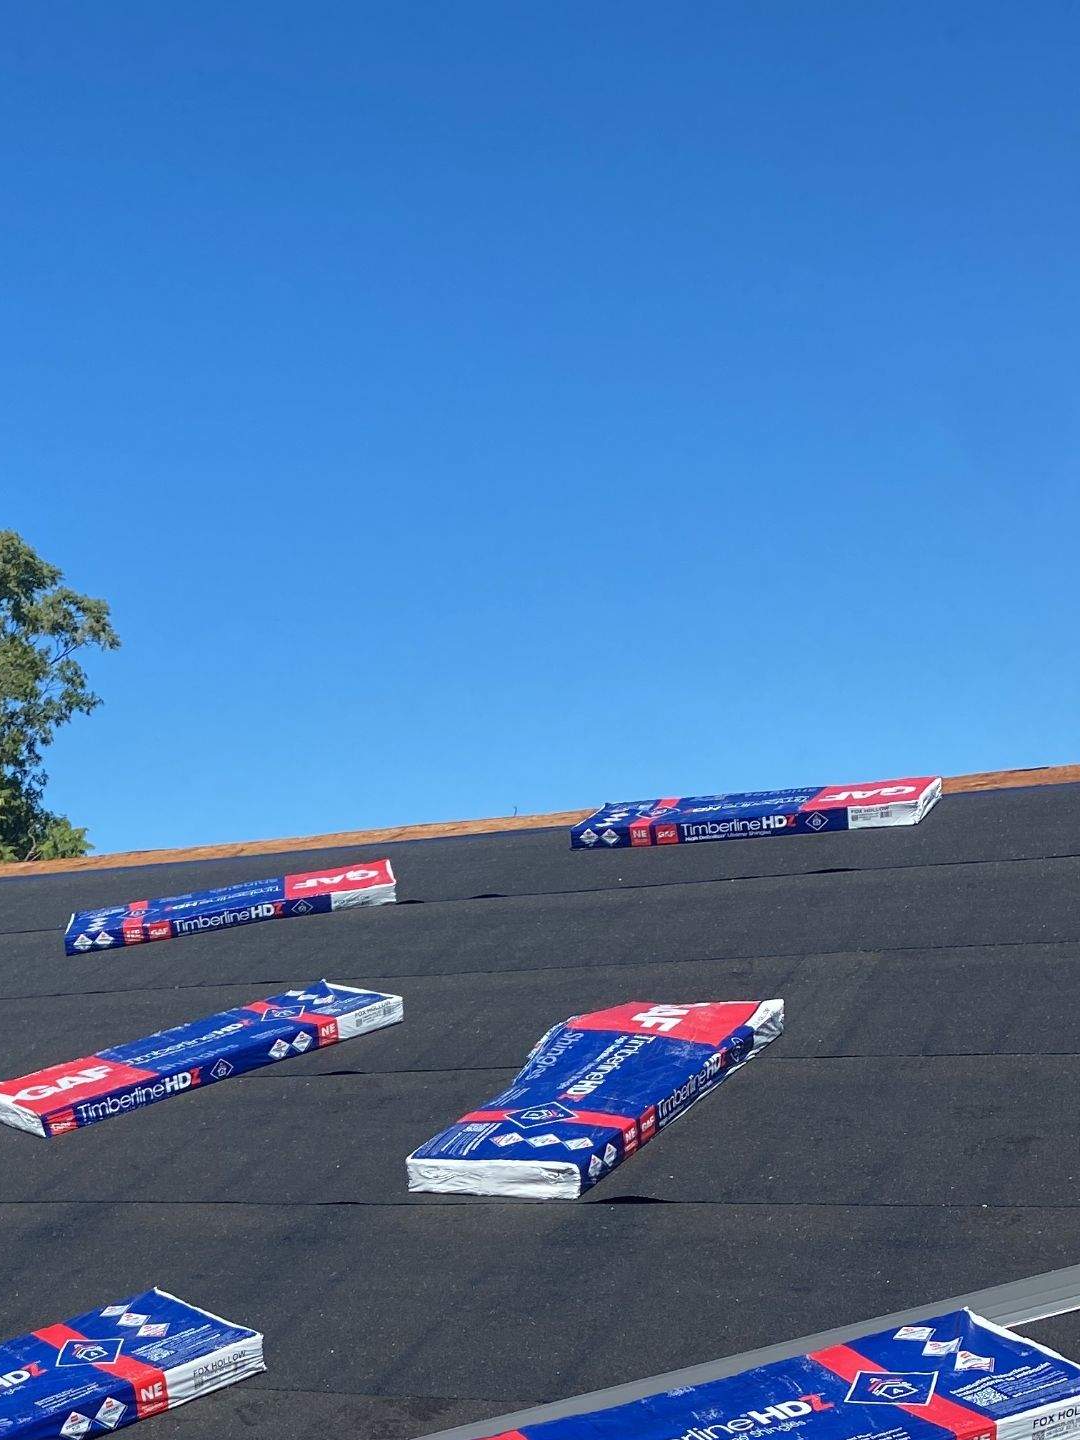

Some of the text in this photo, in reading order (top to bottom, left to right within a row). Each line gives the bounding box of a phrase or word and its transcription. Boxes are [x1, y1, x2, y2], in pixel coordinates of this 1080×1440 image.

[819, 786, 916, 802] GAF
[293, 869, 379, 890] GAF
[321, 1023, 337, 1037] NE
[16, 1065, 114, 1101] GAF
[192, 1349, 247, 1379] FOX HOLLOW
[140, 1381, 164, 1402] NE
[1031, 1412, 1056, 1430] FOX
